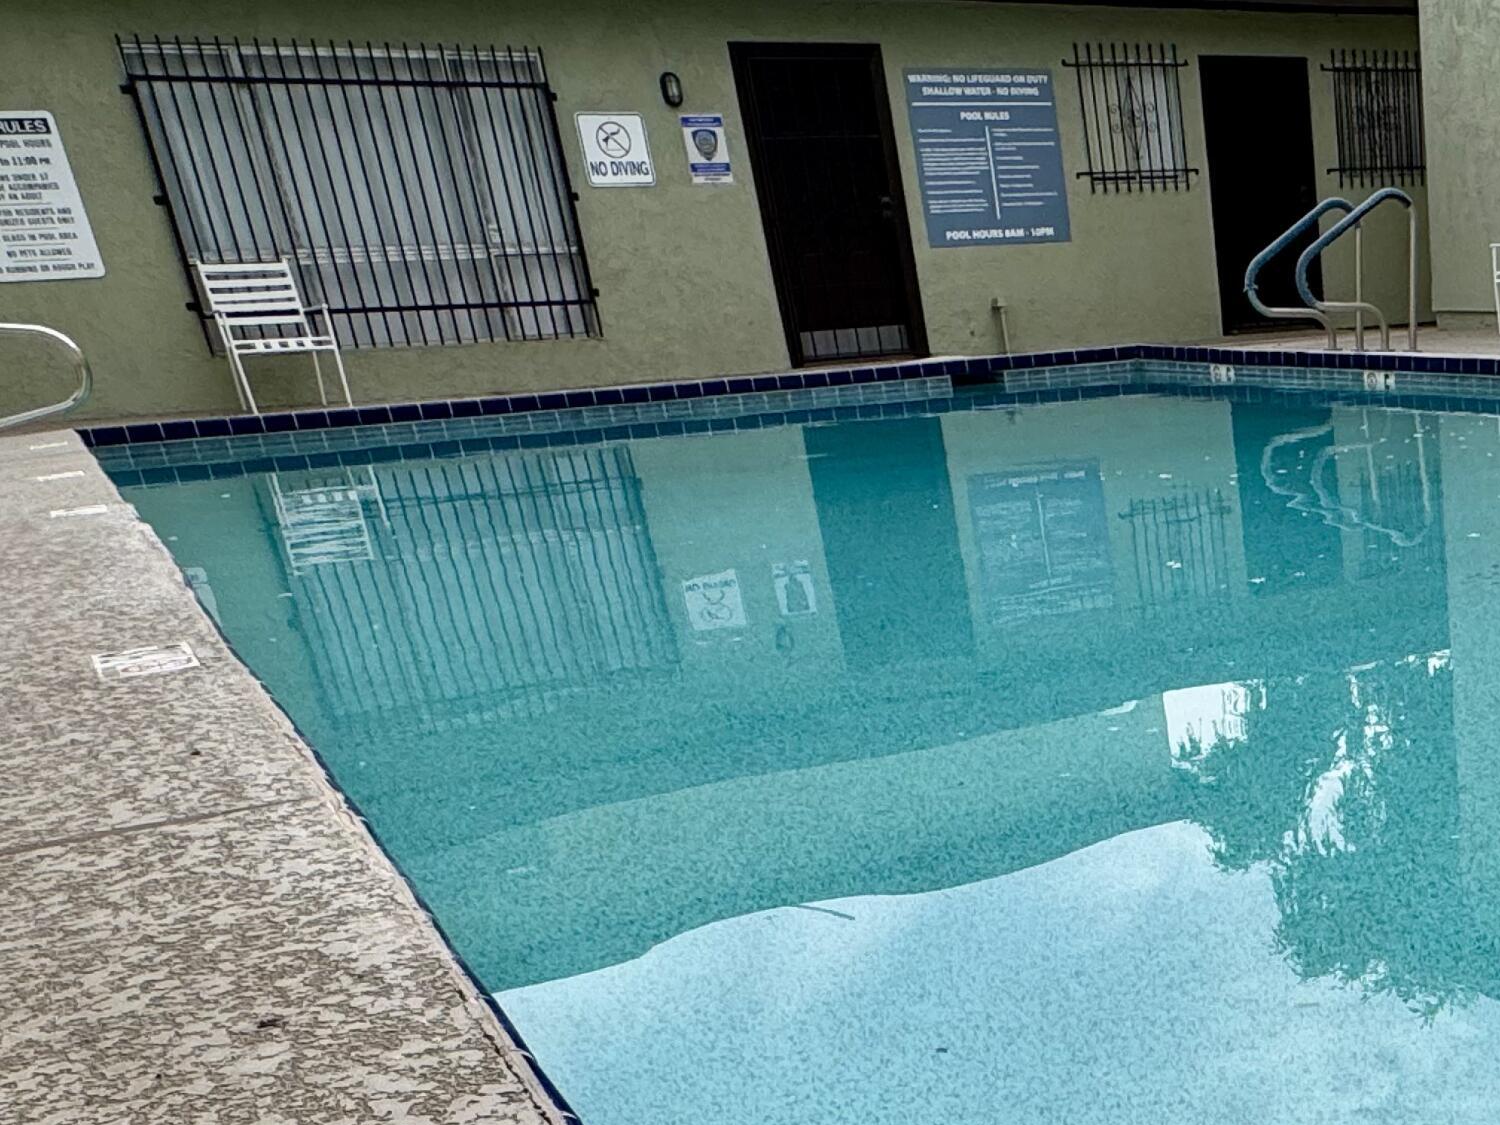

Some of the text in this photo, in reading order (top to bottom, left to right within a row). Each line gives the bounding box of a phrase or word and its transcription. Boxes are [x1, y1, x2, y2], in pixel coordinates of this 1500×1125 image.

[908, 75, 1048, 84] WARNING: NO LIFEGUARD ON DUTY
[922, 87, 962, 96] SHALLOW
[964, 87, 991, 96] WATER
[997, 87, 1009, 95] NO
[1010, 87, 1039, 96] DIVING
[960, 112, 1010, 121] POOL RULES
[590, 161, 651, 176] NO DIVING
[946, 230, 971, 240] POOL
[972, 229, 1004, 239] HOURS
